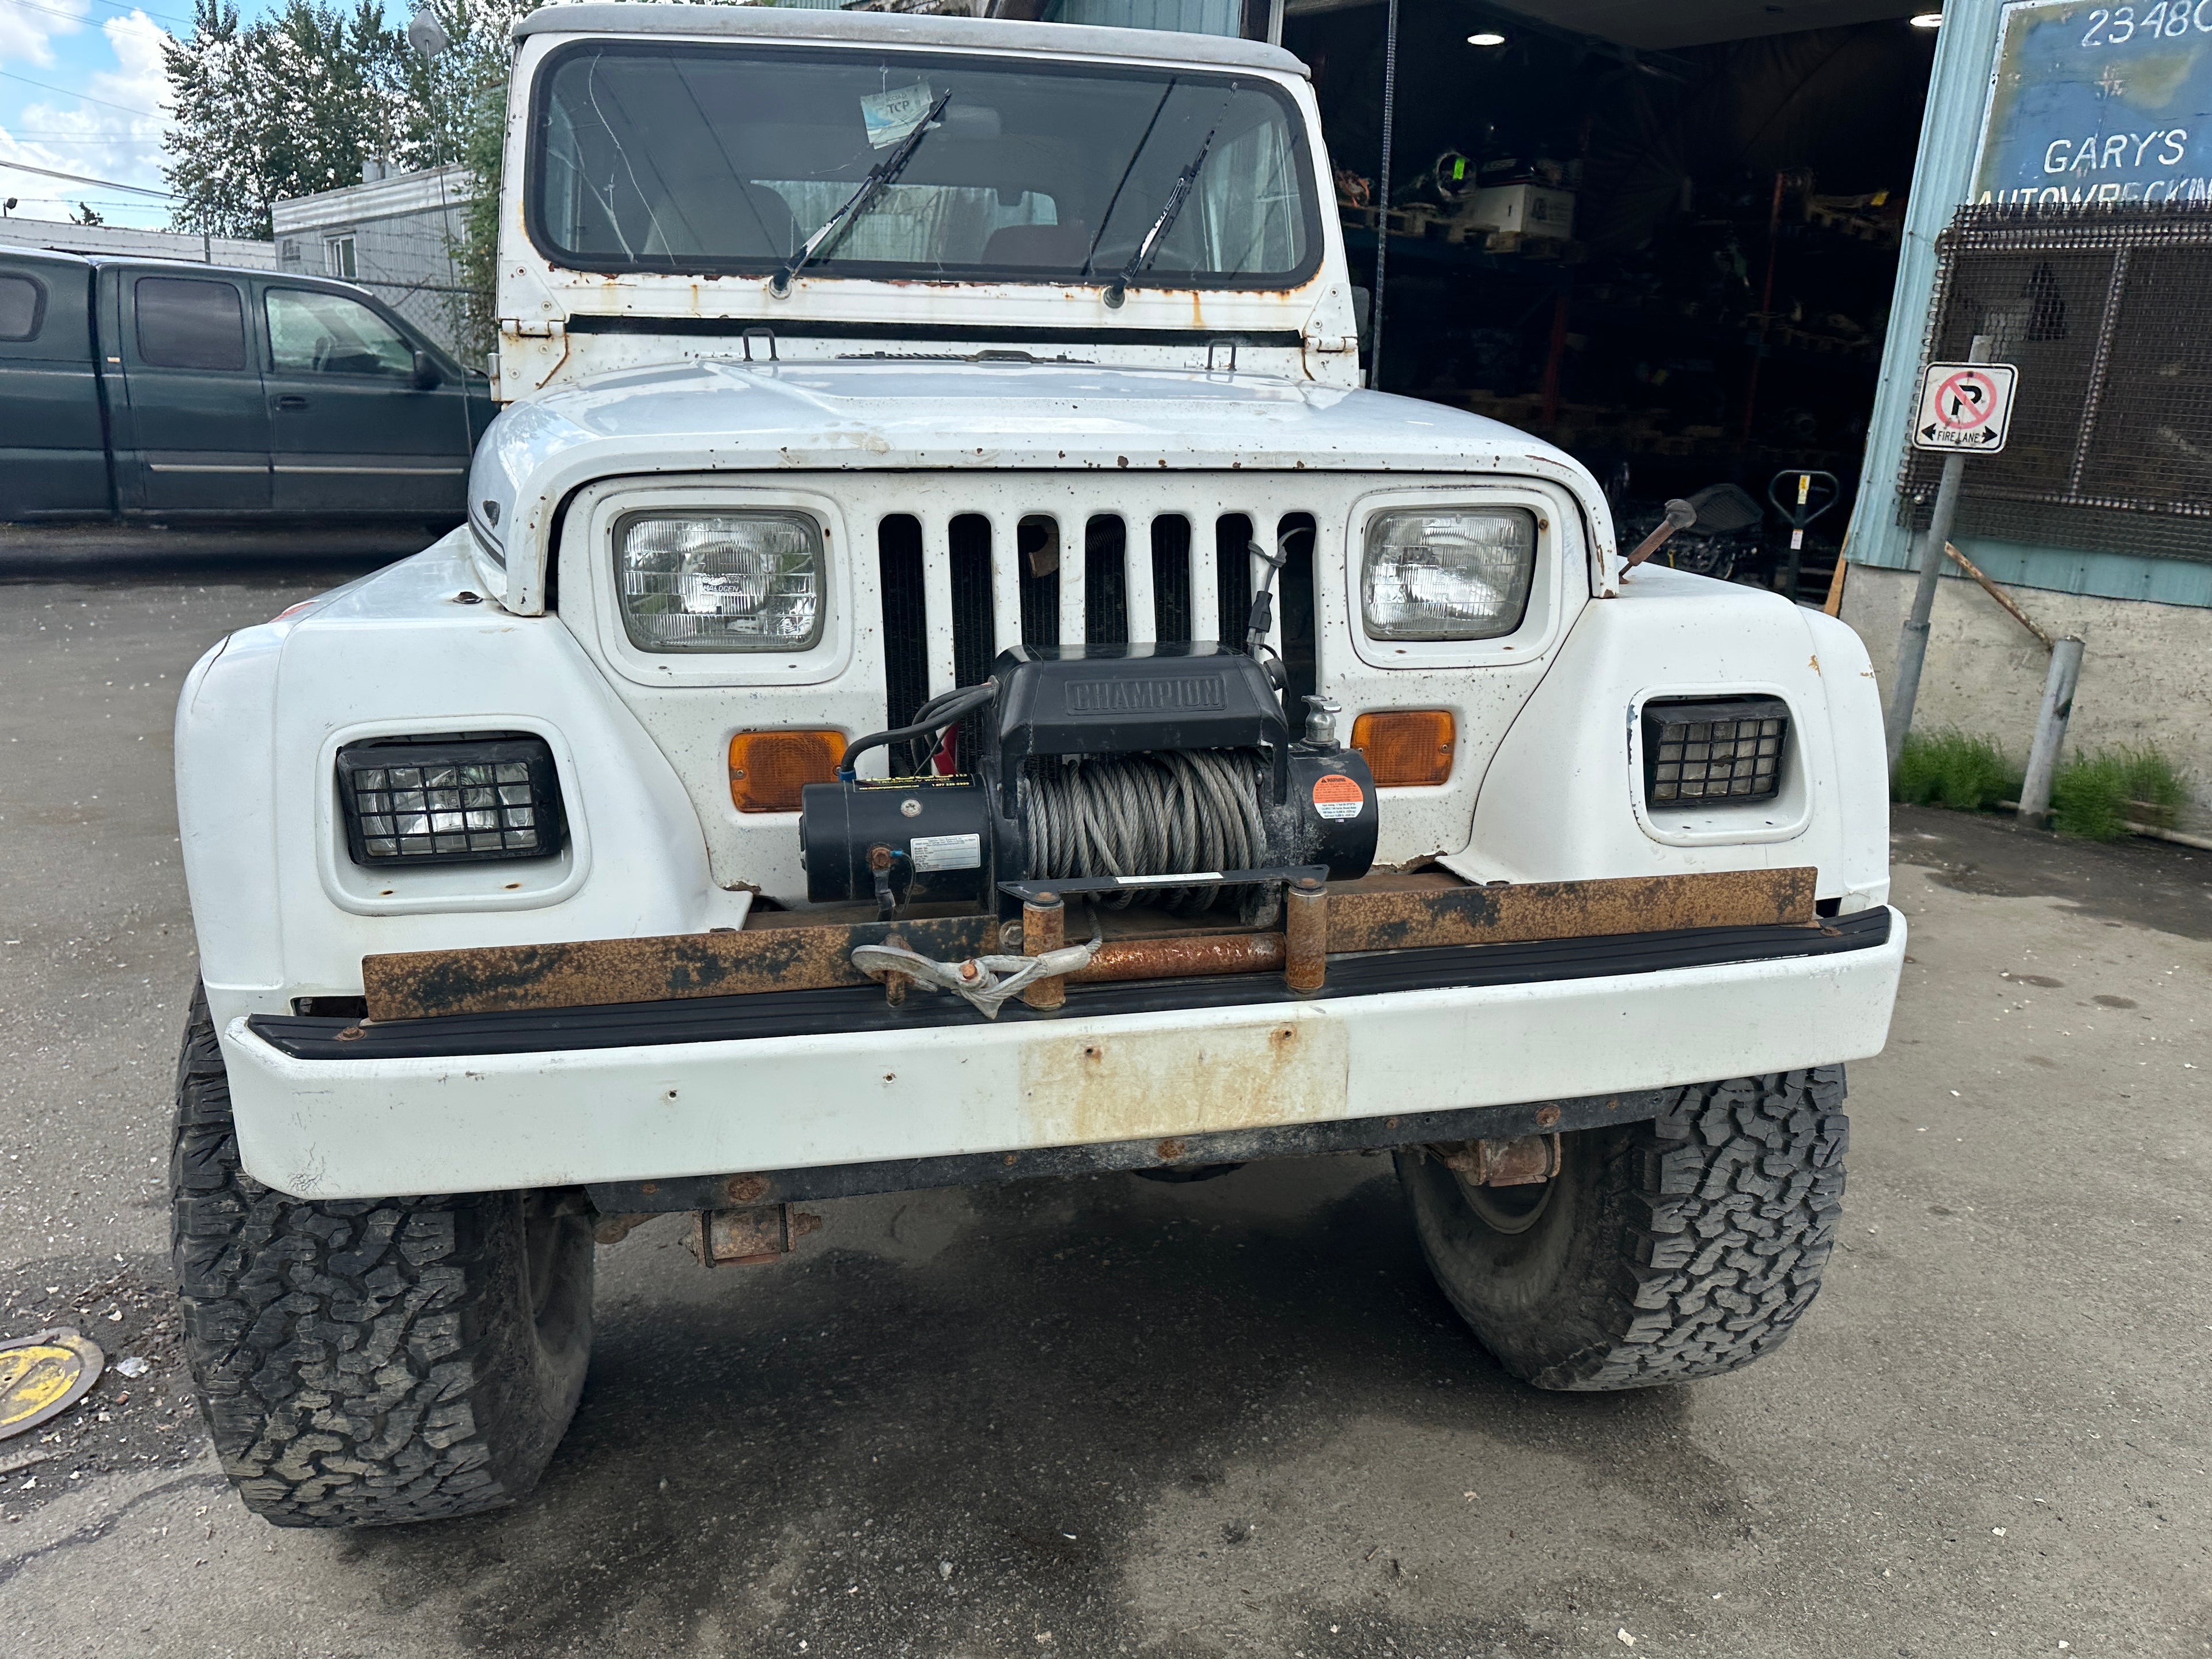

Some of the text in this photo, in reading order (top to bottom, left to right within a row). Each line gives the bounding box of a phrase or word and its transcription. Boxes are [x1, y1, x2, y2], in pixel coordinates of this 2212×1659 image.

[887, 100, 910, 114] TCP
[2044, 129, 2188, 173] GARY'S
[1937, 431, 1982, 443] FIRE LANE
[1074, 677, 1221, 710] CHAMPION
